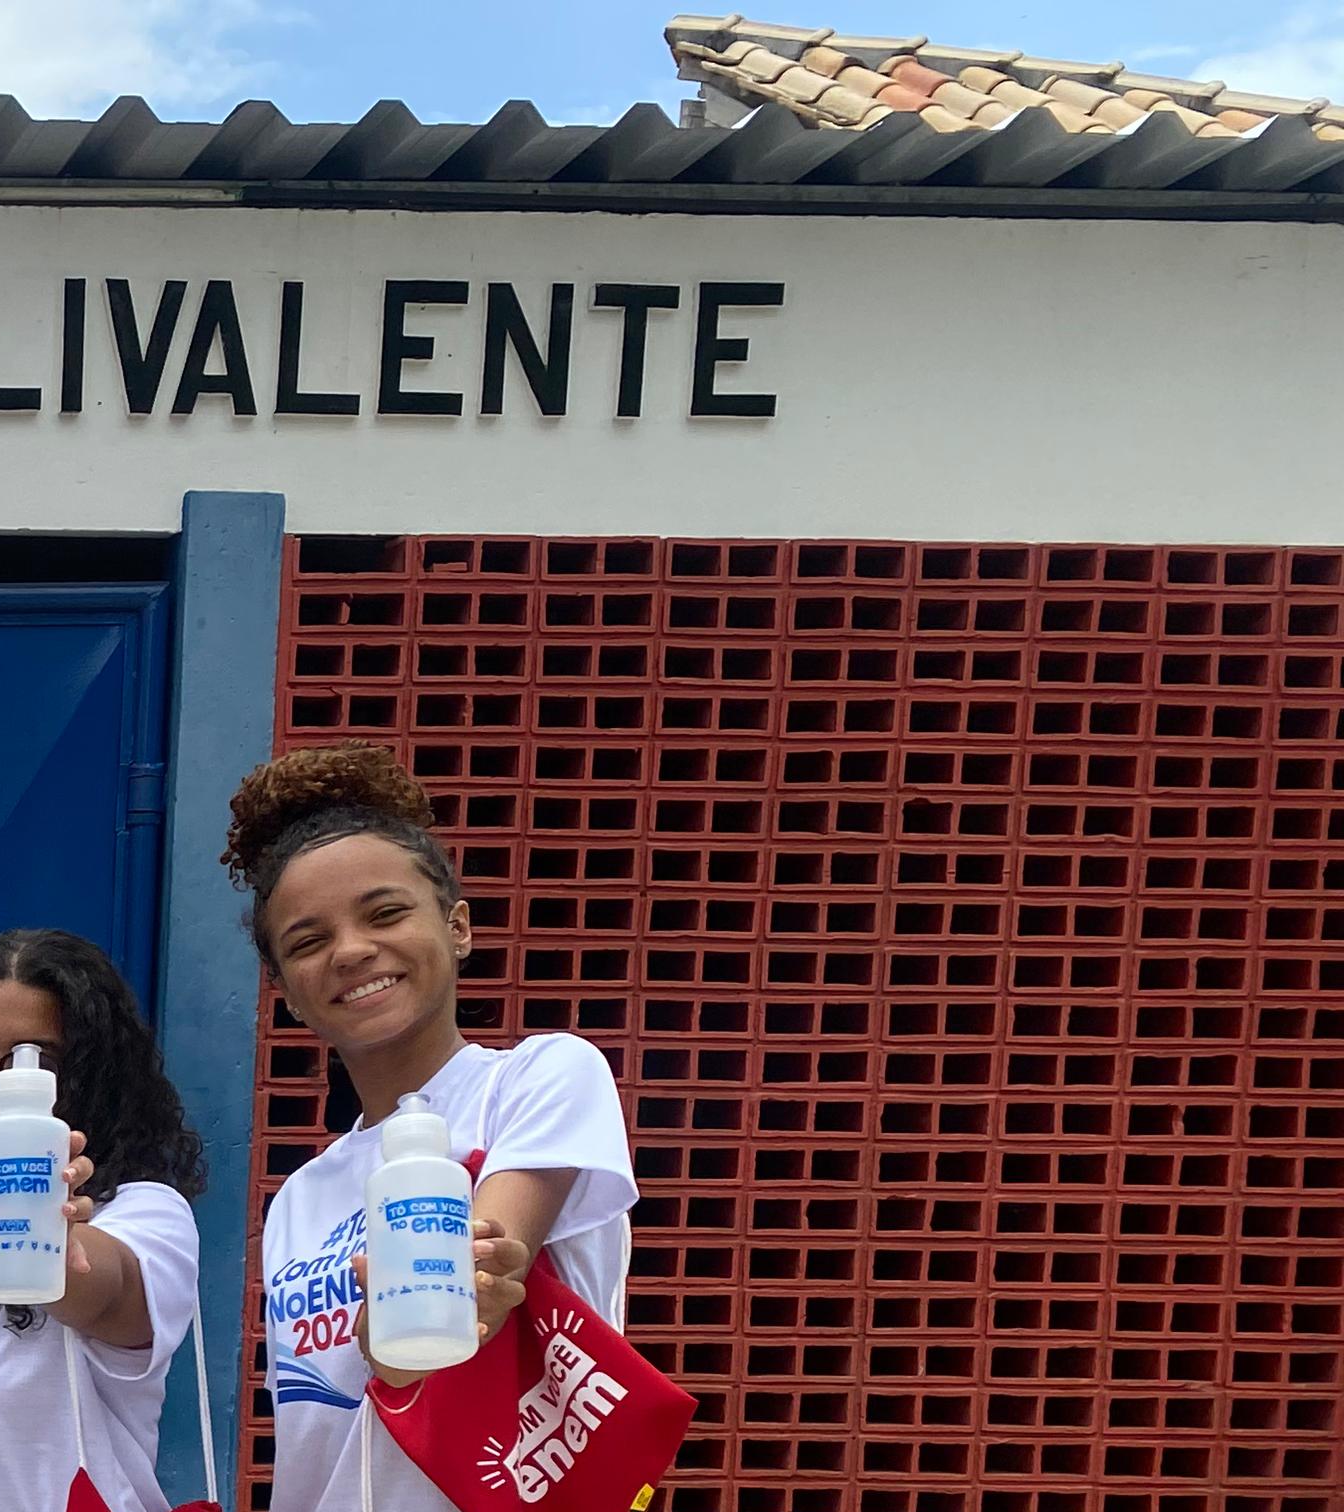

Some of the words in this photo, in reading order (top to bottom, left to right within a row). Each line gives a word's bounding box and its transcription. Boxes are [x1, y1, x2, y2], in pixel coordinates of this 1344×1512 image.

[389, 1203, 406, 1217] TÔ
[412, 1202, 437, 1213] COM
[390, 1219, 408, 1231] no
[412, 1217, 468, 1237] enem
[269, 1267, 365, 1326] NoENE
[292, 1308, 362, 1358] 202
[539, 1344, 581, 1408] VOCÊ
[517, 1371, 629, 1503] enem
